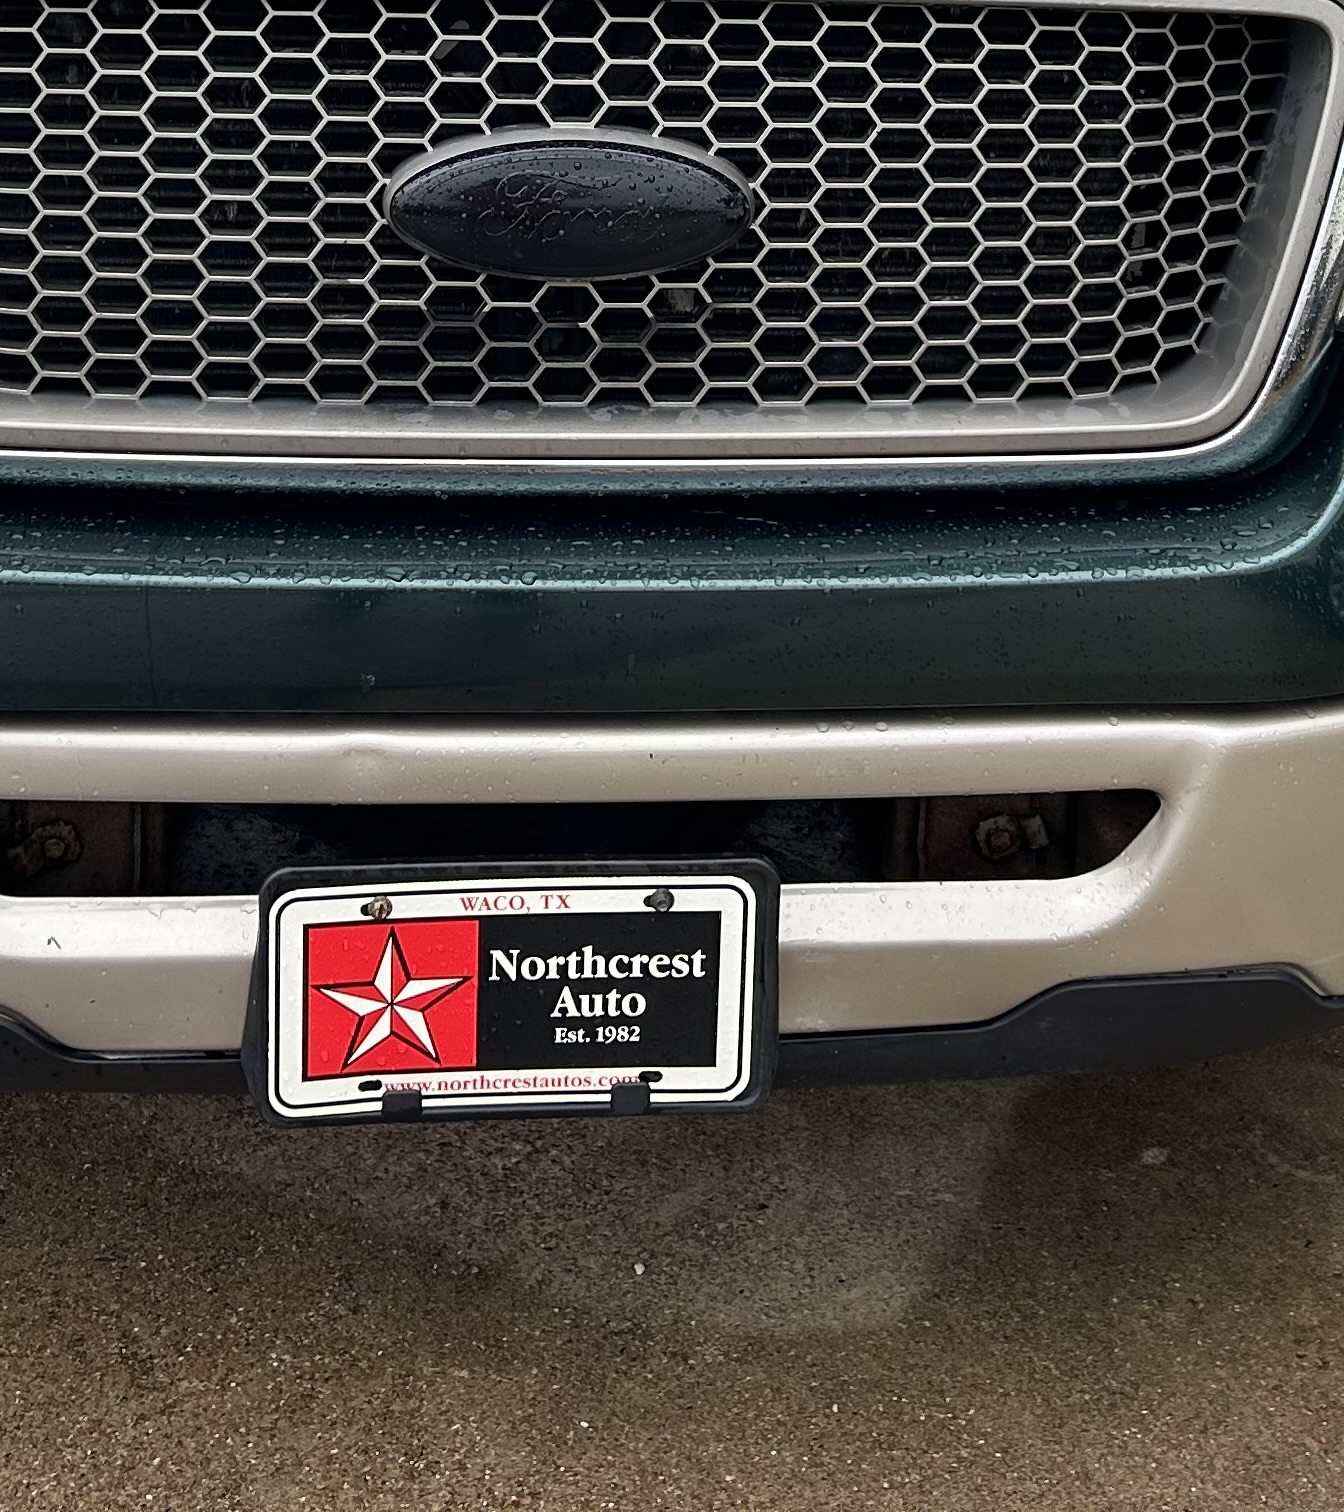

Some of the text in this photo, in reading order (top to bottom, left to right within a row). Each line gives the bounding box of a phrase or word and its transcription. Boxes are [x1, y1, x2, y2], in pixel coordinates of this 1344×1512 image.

[460, 894, 572, 914] WACO, TX
[488, 945, 707, 982] Northcrest
[550, 985, 647, 1018] Auto
[554, 1024, 641, 1044] Est. 1982
